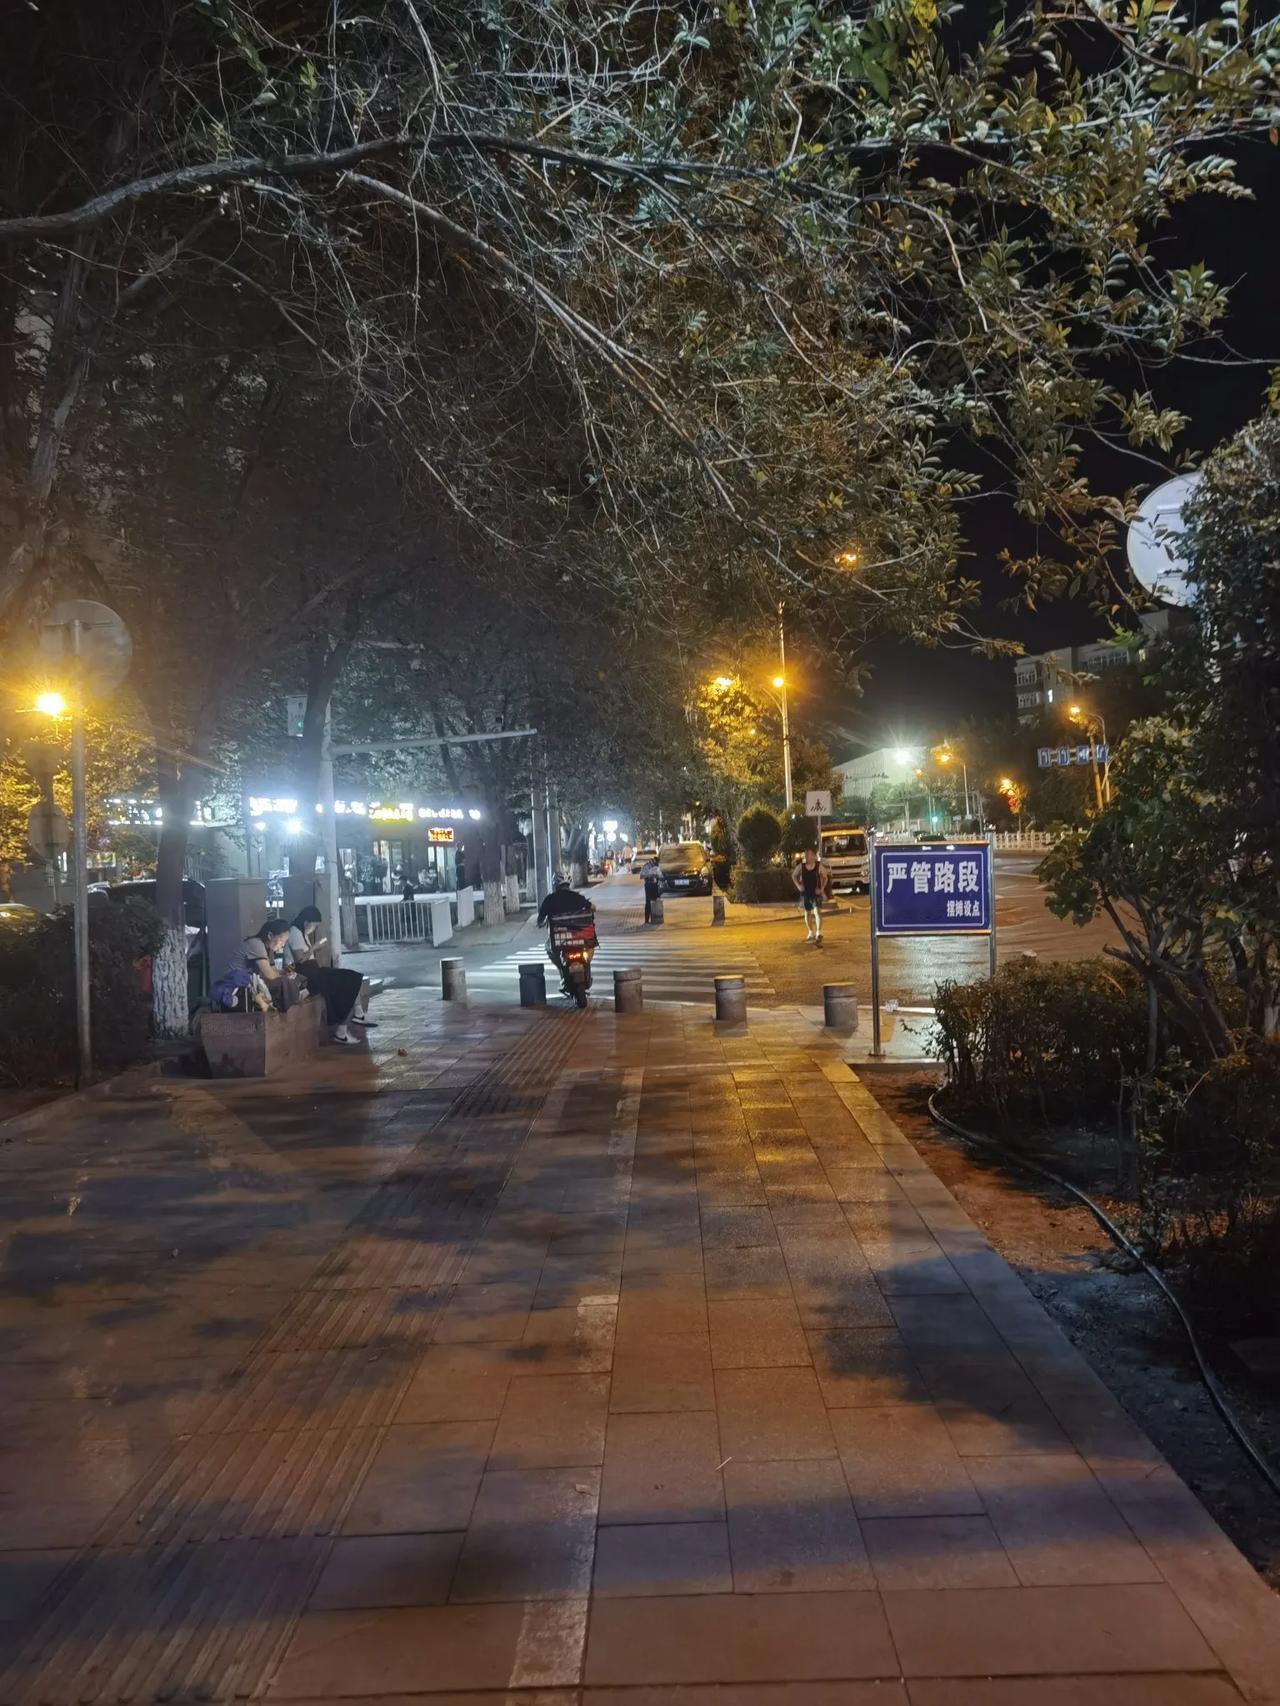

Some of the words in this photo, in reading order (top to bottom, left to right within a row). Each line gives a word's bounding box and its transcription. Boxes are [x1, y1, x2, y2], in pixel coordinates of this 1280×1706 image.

[886, 861, 979, 893] 严管路段
[947, 900, 980, 917] 摆摊设点
